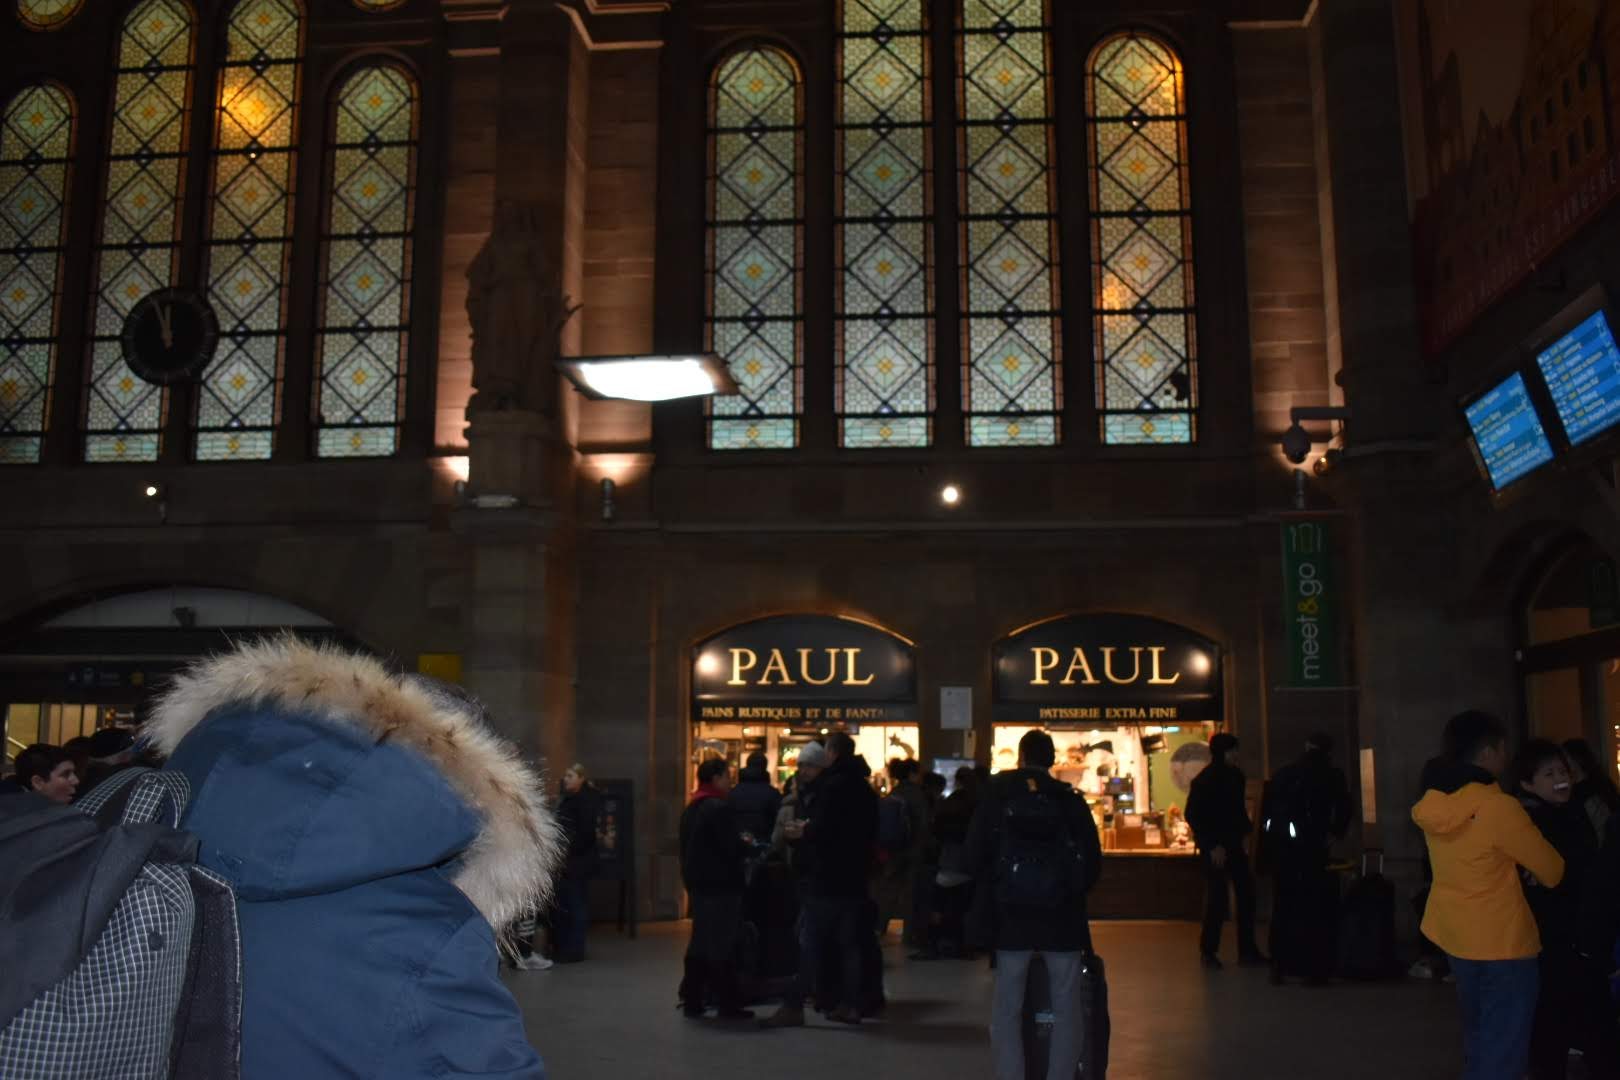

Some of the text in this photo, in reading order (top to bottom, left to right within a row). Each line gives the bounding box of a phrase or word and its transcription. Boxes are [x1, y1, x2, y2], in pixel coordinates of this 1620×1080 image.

[727, 647, 876, 686] PAUL
[1030, 646, 1180, 685] PAUL
[702, 707, 734, 718] PAINS
[738, 707, 800, 719] RUSTIQUES
[806, 708, 820, 718] ET
[826, 708, 841, 718] DE
[1105, 707, 1146, 719] EXTRA
[1150, 708, 1177, 718] FINE
